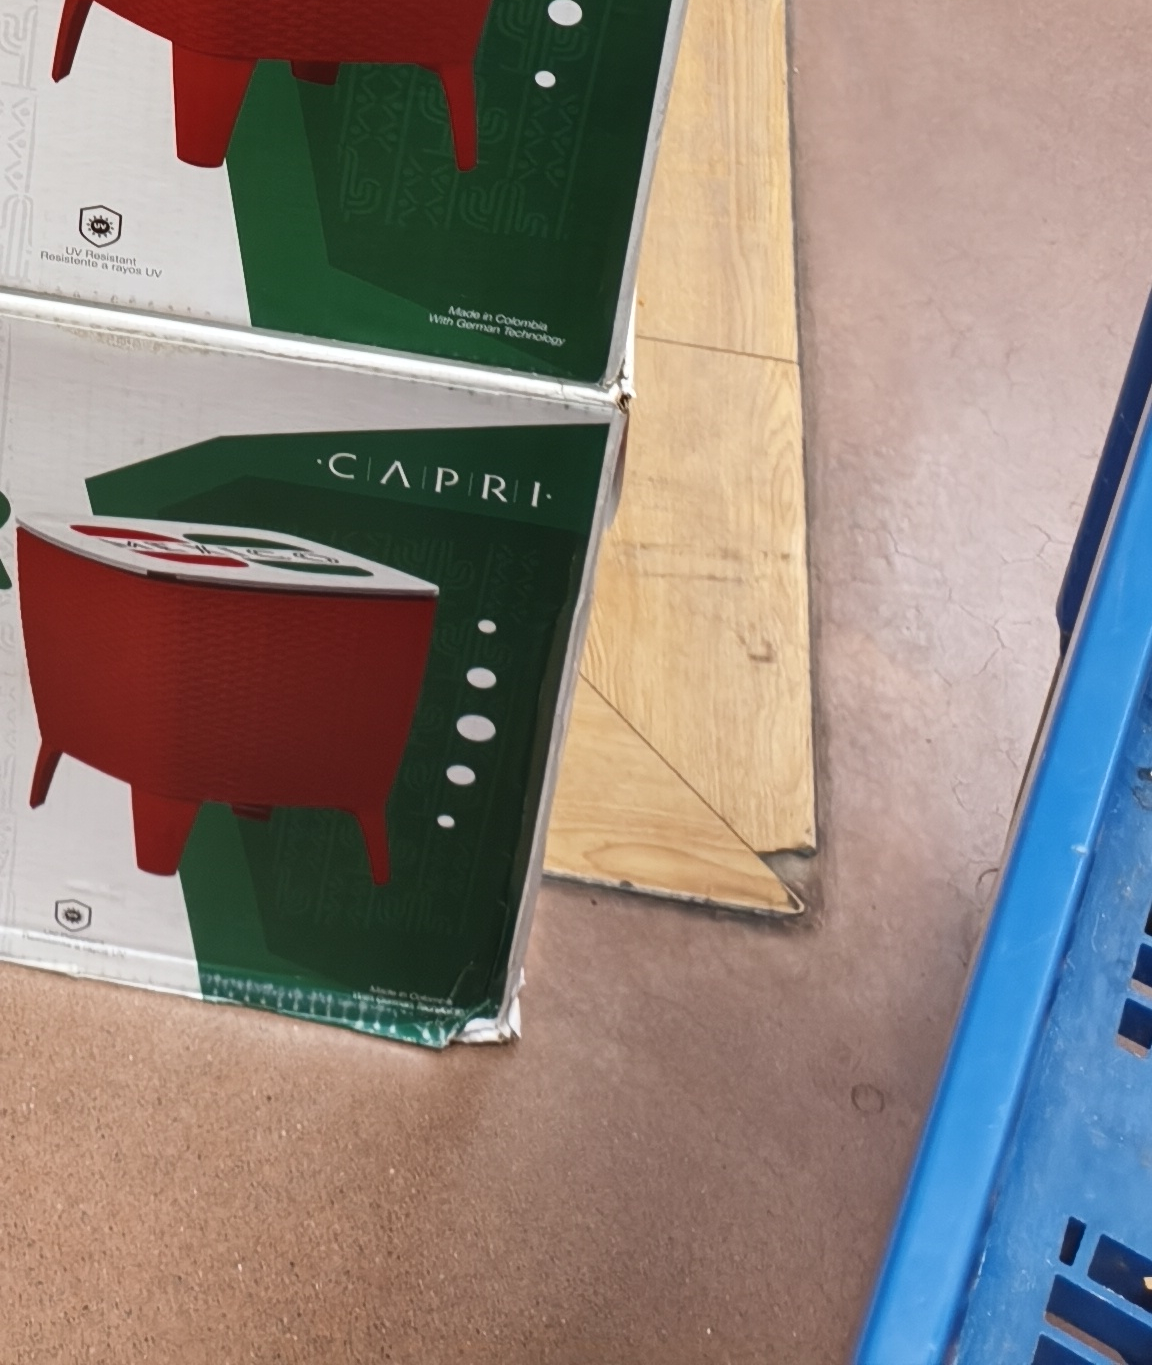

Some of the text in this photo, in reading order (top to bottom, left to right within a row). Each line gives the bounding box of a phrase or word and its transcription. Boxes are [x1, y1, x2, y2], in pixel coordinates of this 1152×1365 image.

[40, 251, 98, 268] Resistente
[111, 263, 142, 275] rayos
[86, 249, 136, 266] Resistant
[428, 313, 565, 347] With German Technology
[448, 305, 548, 332] Made in Colombia
